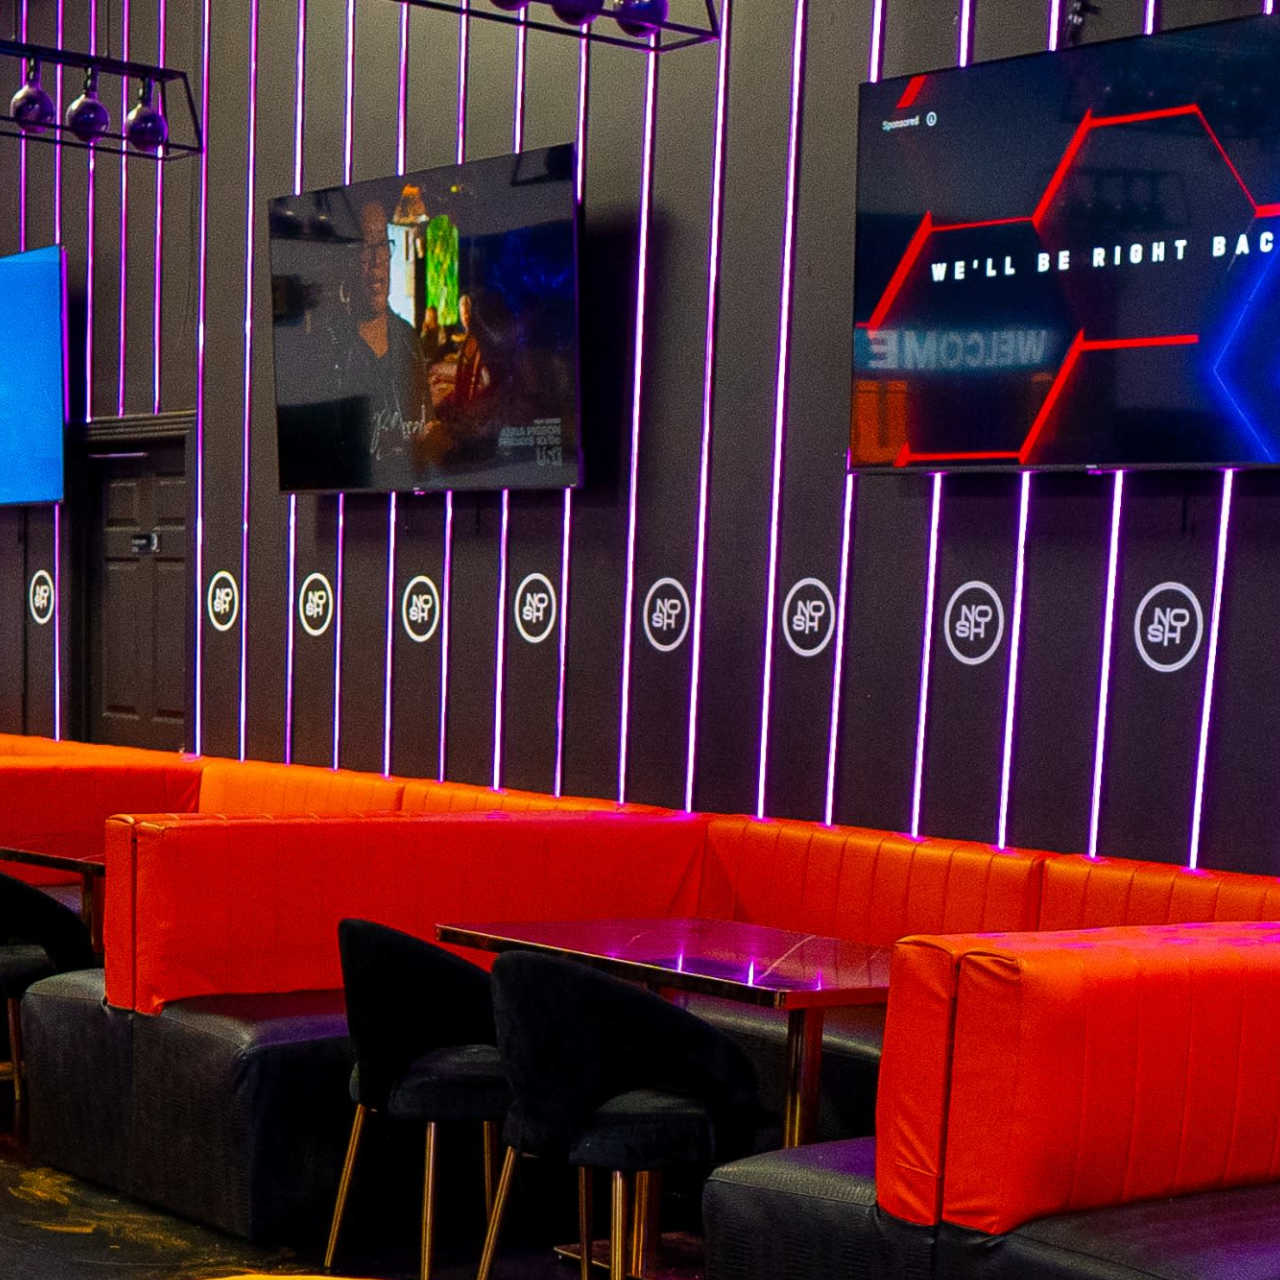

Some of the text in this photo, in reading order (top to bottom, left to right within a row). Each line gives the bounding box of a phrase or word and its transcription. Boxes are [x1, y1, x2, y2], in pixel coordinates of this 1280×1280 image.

[930, 256, 1016, 282] WE'LL
[1037, 251, 1071, 272] BE
[1093, 239, 1188, 267] RIGHT
[656, 598, 681, 614] NO
[797, 600, 825, 616] NO
[960, 604, 992, 622] NO
[651, 613, 675, 631] SH
[792, 615, 819, 635] SH
[1154, 607, 1190, 627] NO
[955, 621, 985, 641] SH
[1147, 625, 1181, 646] SH
